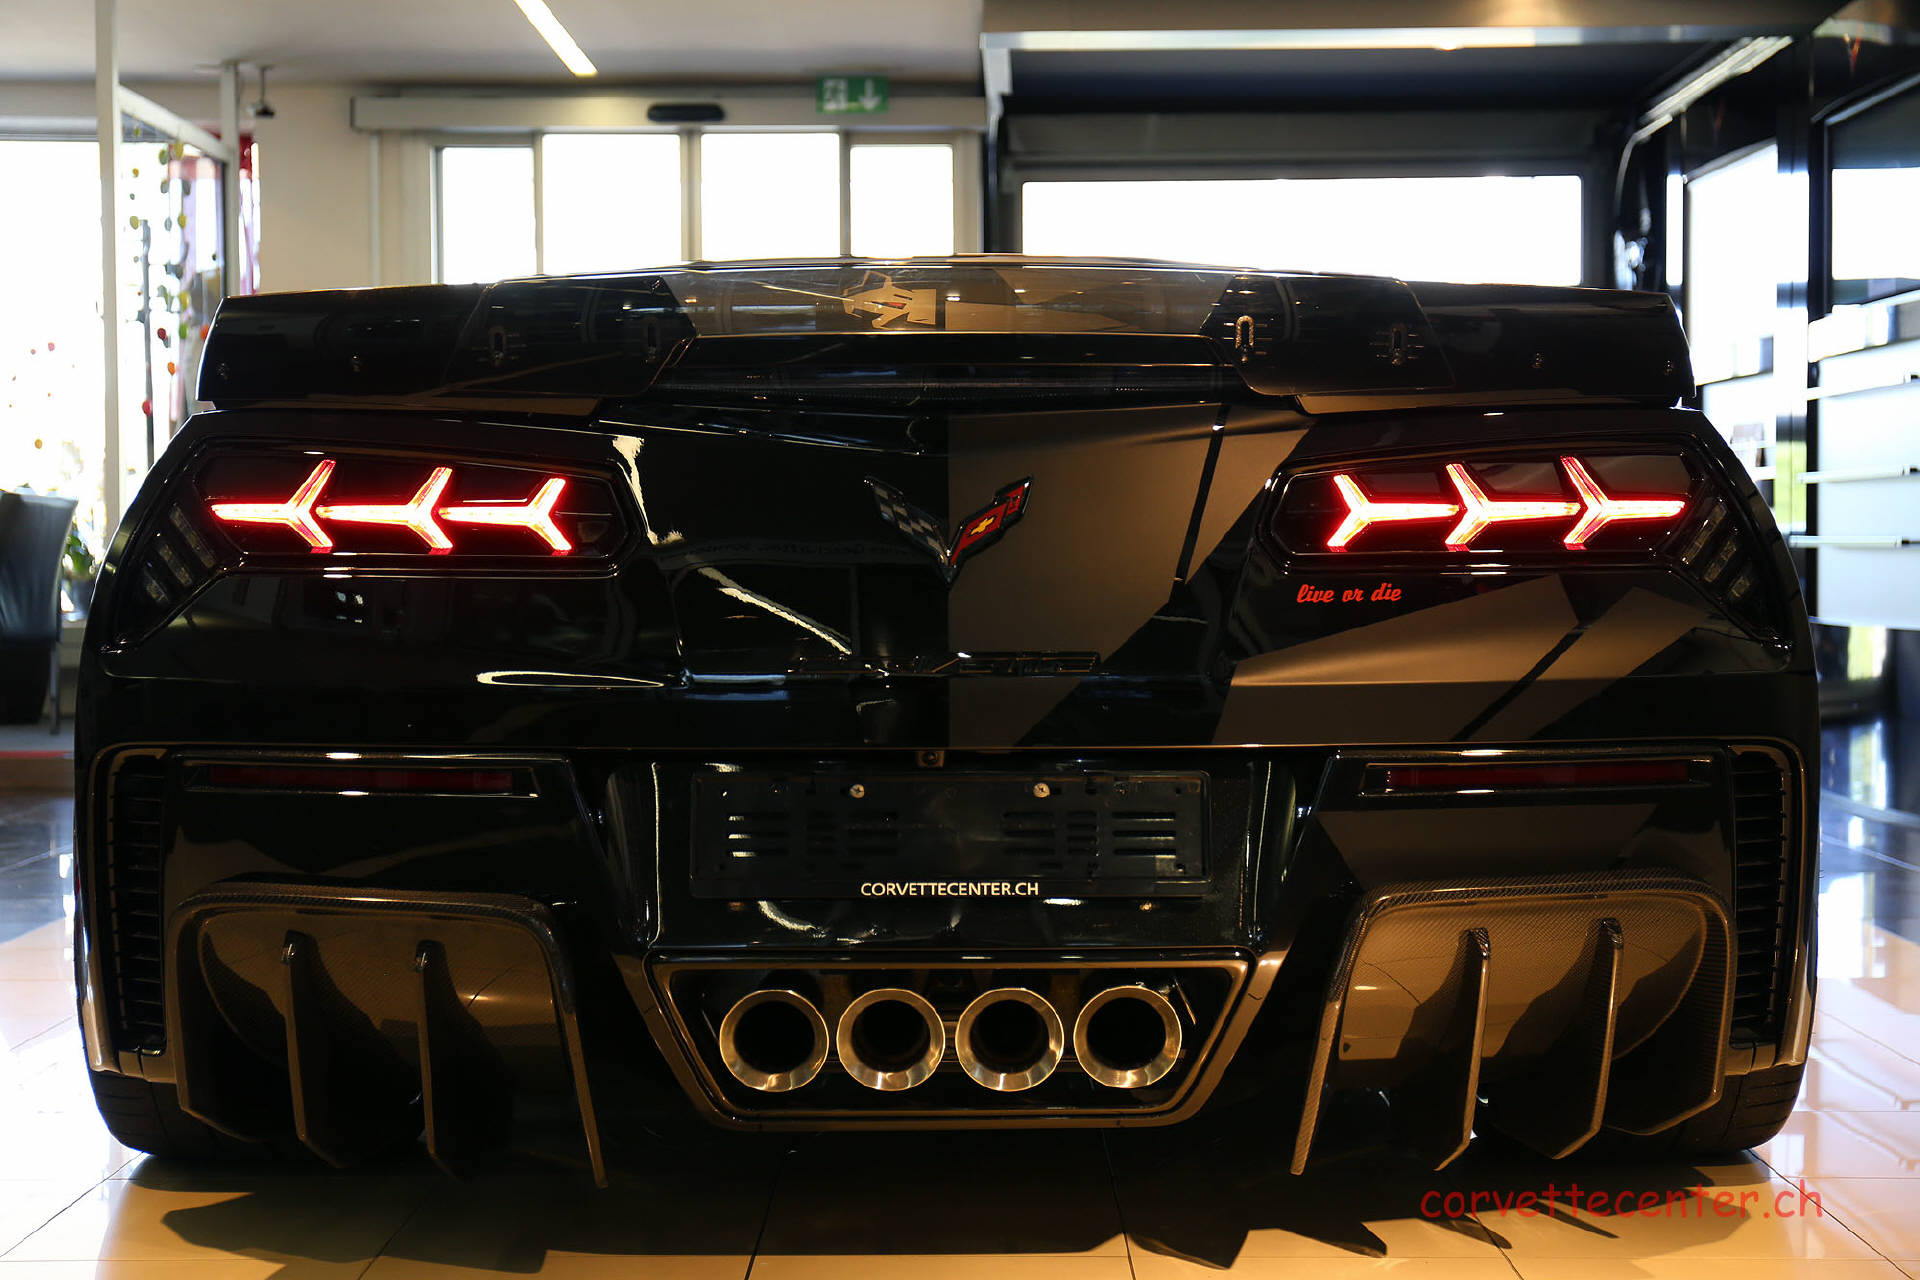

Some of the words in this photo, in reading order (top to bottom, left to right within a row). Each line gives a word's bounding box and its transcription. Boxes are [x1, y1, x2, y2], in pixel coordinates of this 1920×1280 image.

[1297, 584, 1335, 603] live
[1342, 588, 1364, 603] or
[1371, 582, 1402, 602] die
[860, 882, 1040, 896] CORVETTECENTER.CH
